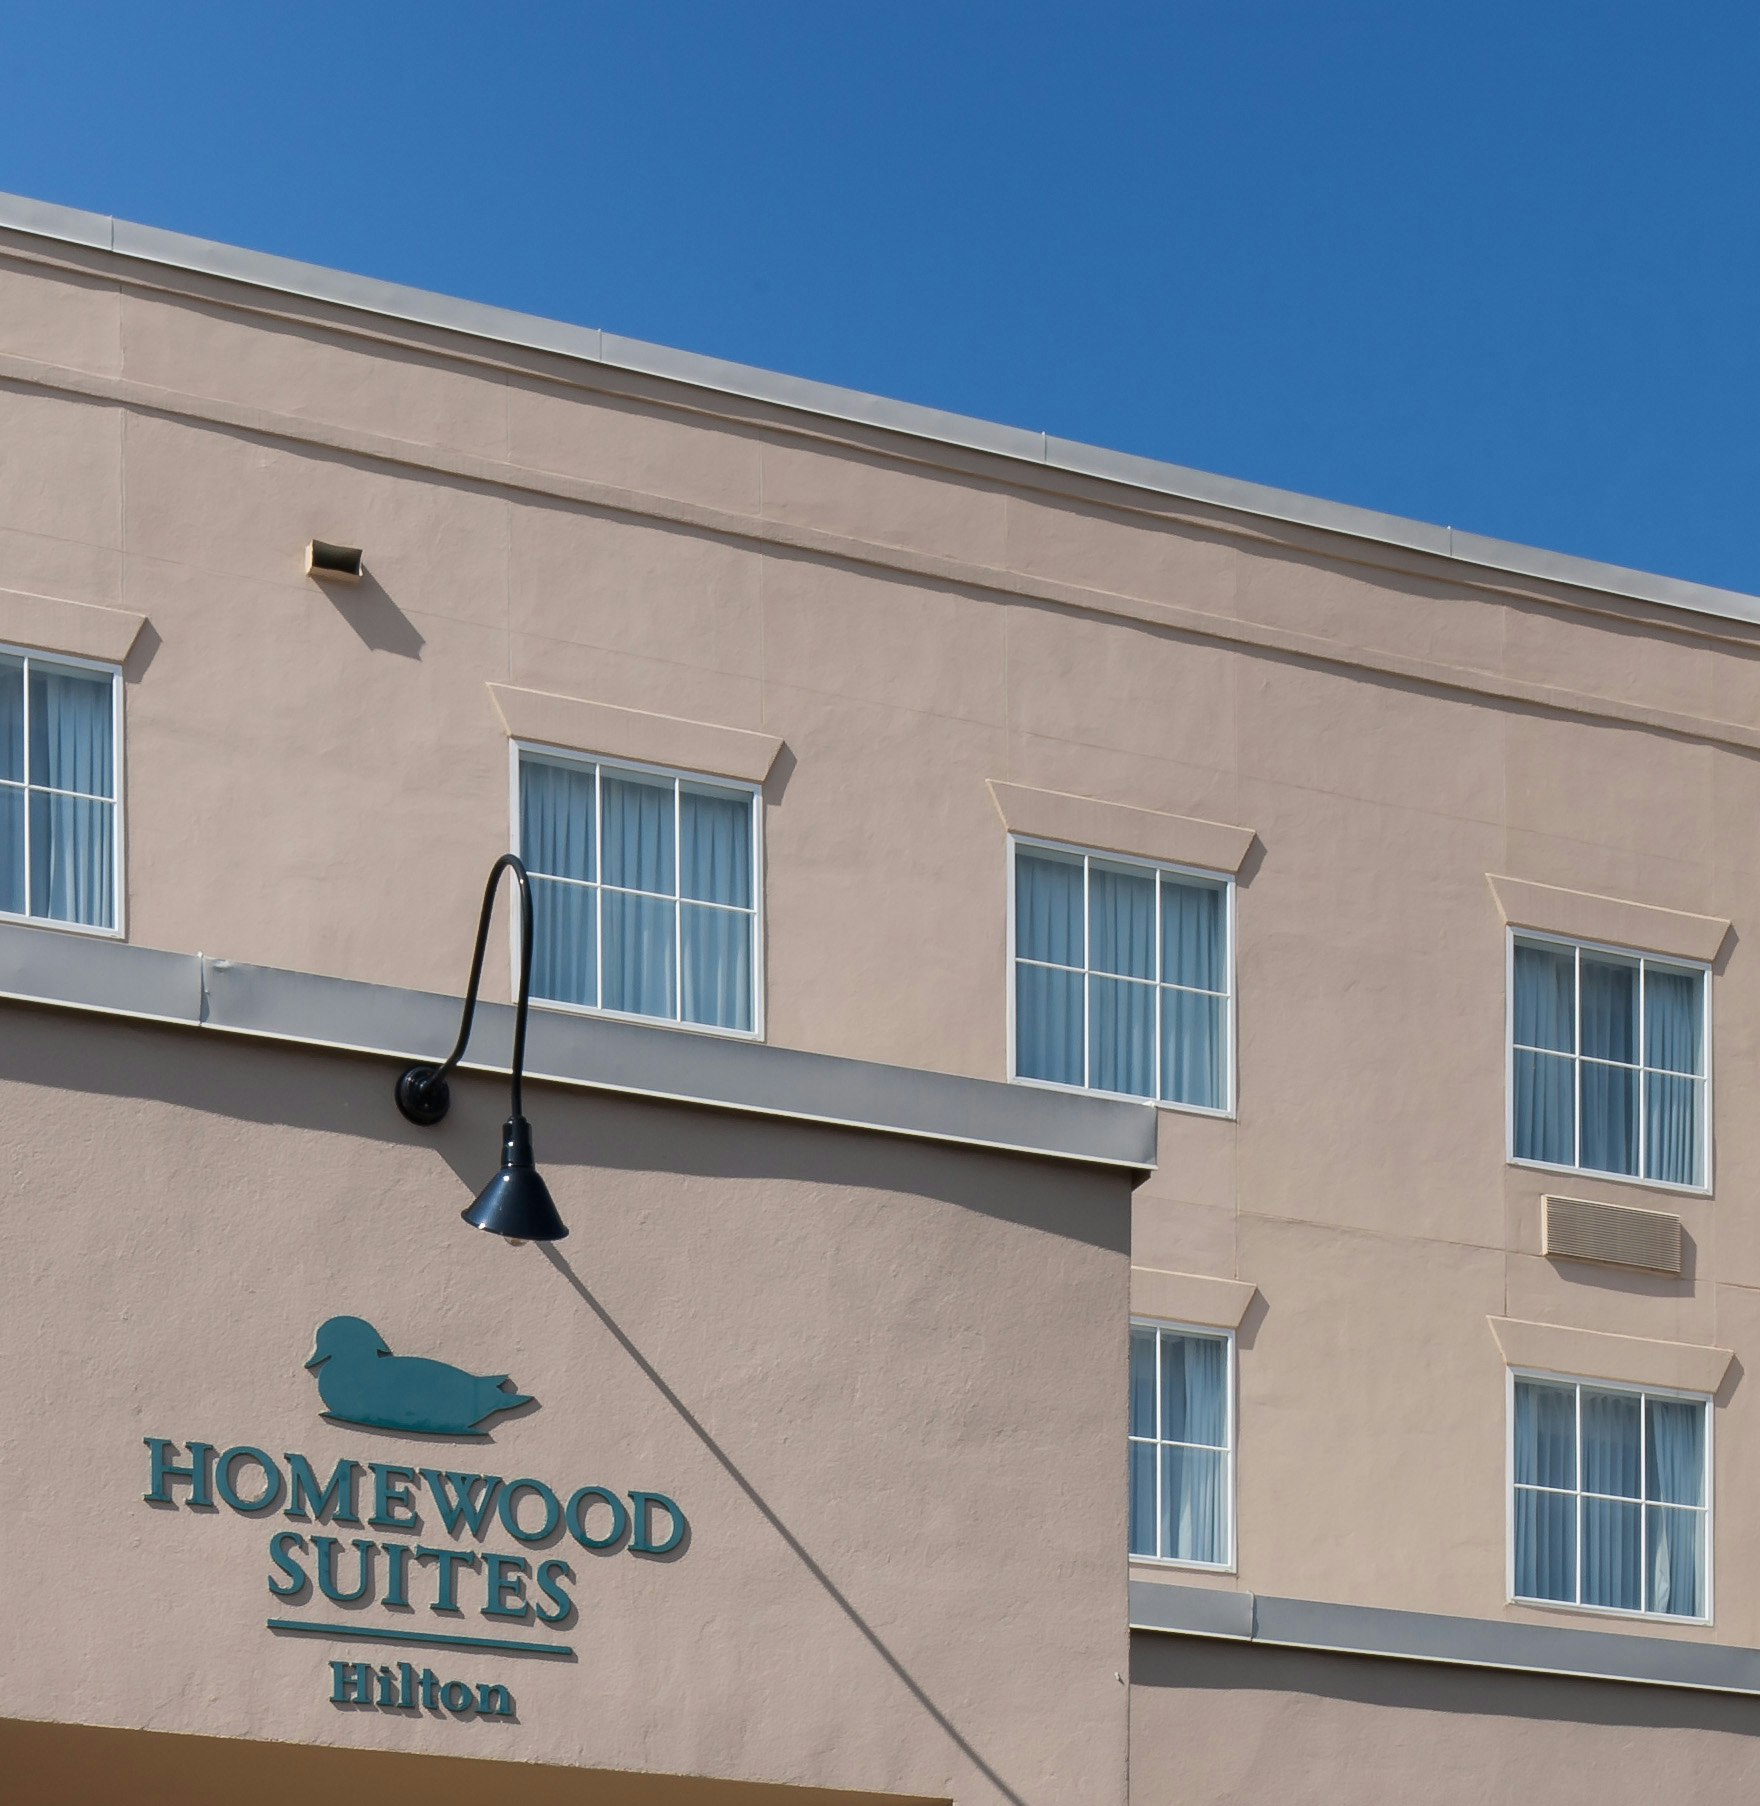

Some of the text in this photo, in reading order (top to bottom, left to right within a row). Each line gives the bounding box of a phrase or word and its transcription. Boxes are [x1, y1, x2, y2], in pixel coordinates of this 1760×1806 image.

[143, 1436, 686, 1554] HOMEWOOD
[268, 1531, 572, 1624] SUITES
[329, 1660, 514, 1716] Hilton
